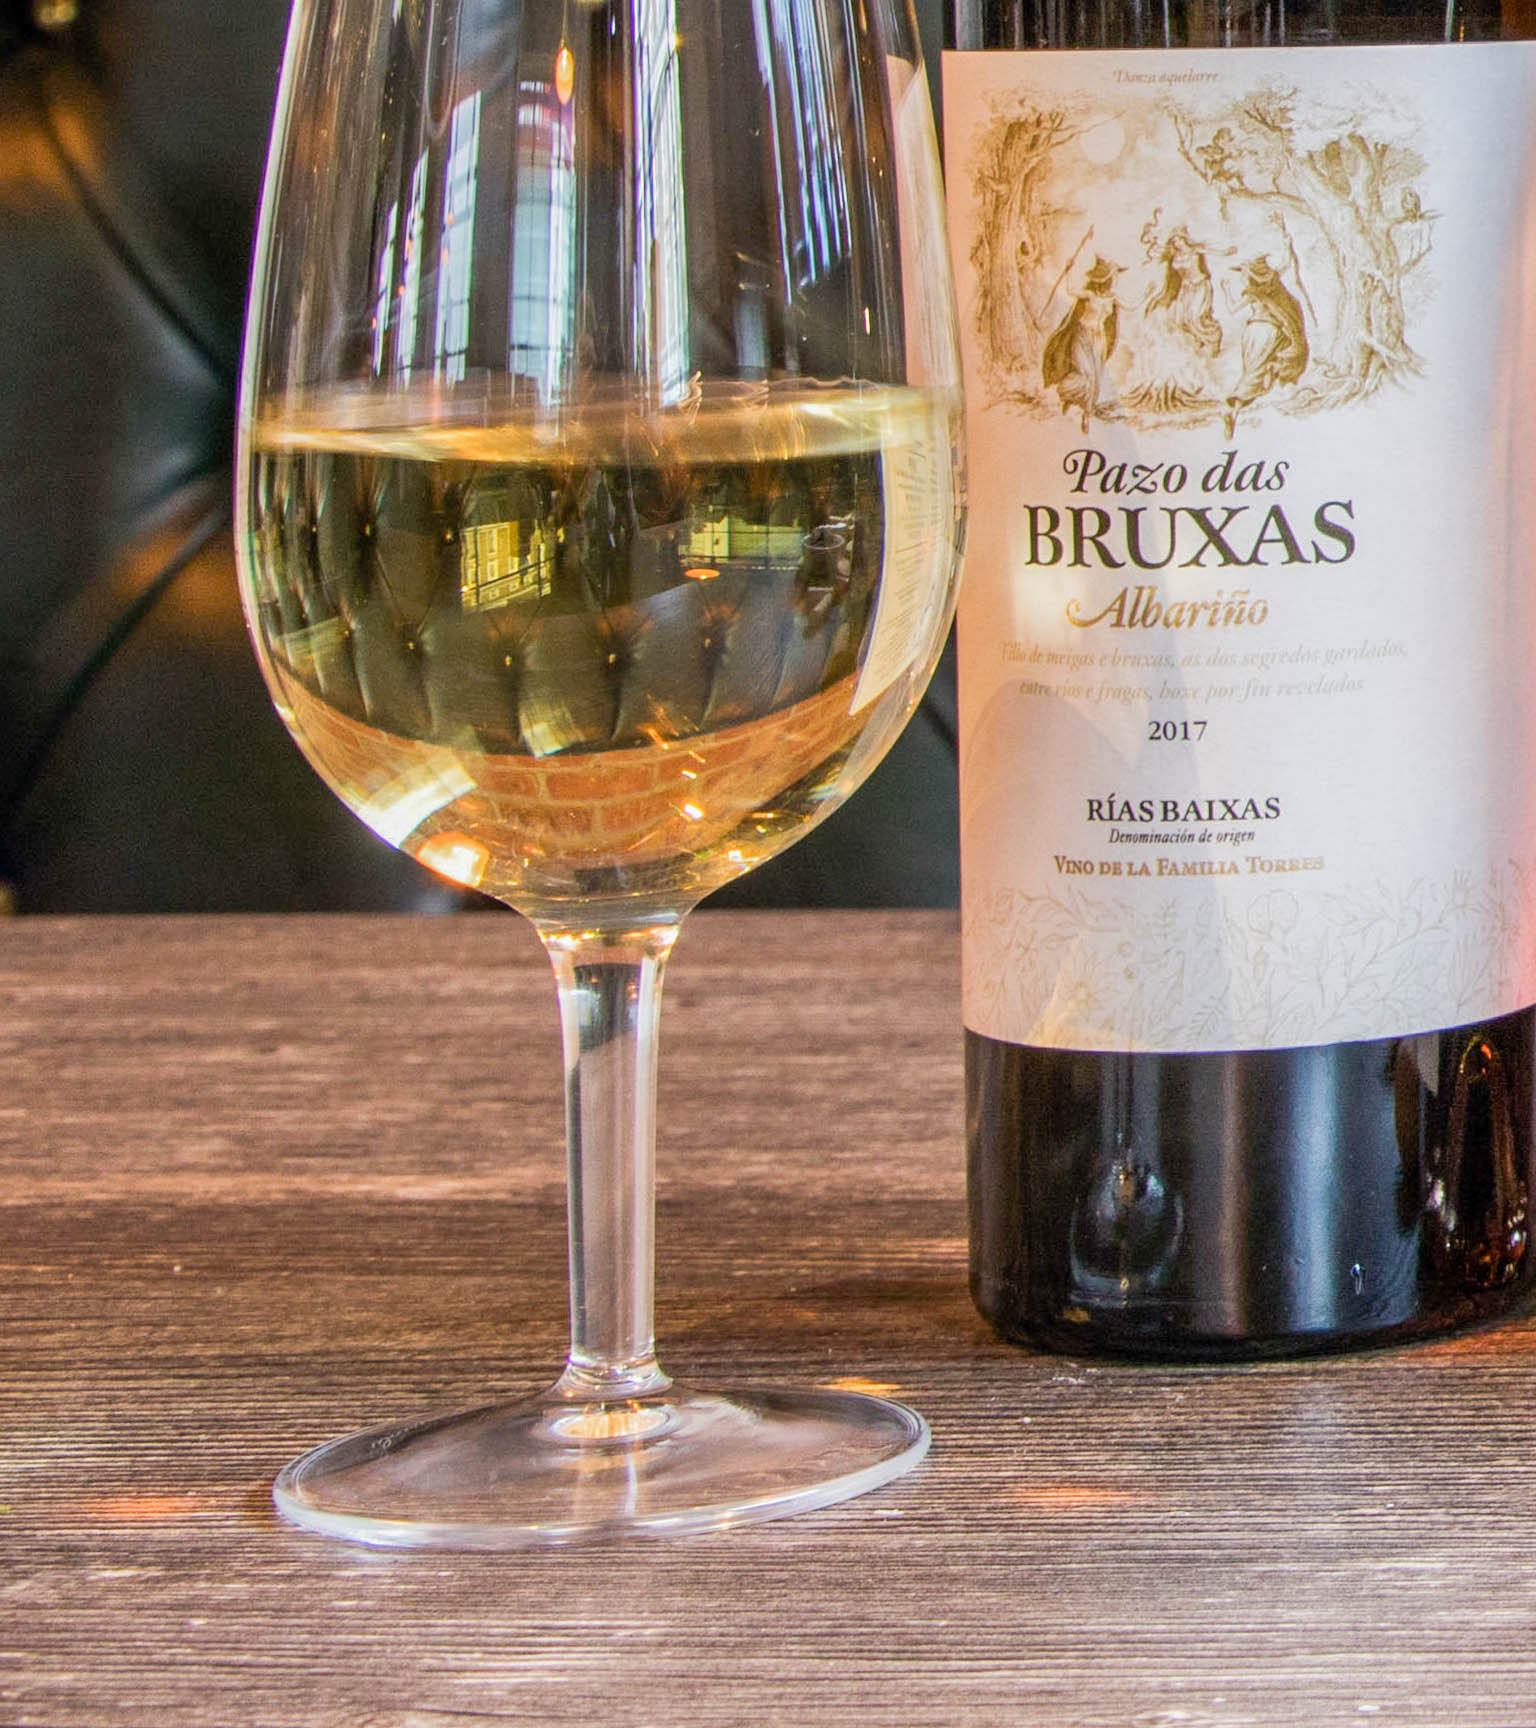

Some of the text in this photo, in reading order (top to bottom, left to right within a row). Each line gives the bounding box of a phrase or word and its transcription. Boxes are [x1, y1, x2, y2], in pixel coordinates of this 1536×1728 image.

[1063, 449, 1290, 495] Pazo das
[1023, 500, 1356, 569] BRUXAS
[1066, 585, 1269, 630] Albariño
[1148, 721, 1208, 741] 2017
[1087, 793, 1281, 822] RÍAS BAIXAS
[1108, 828, 1255, 846] Denominación de origen
